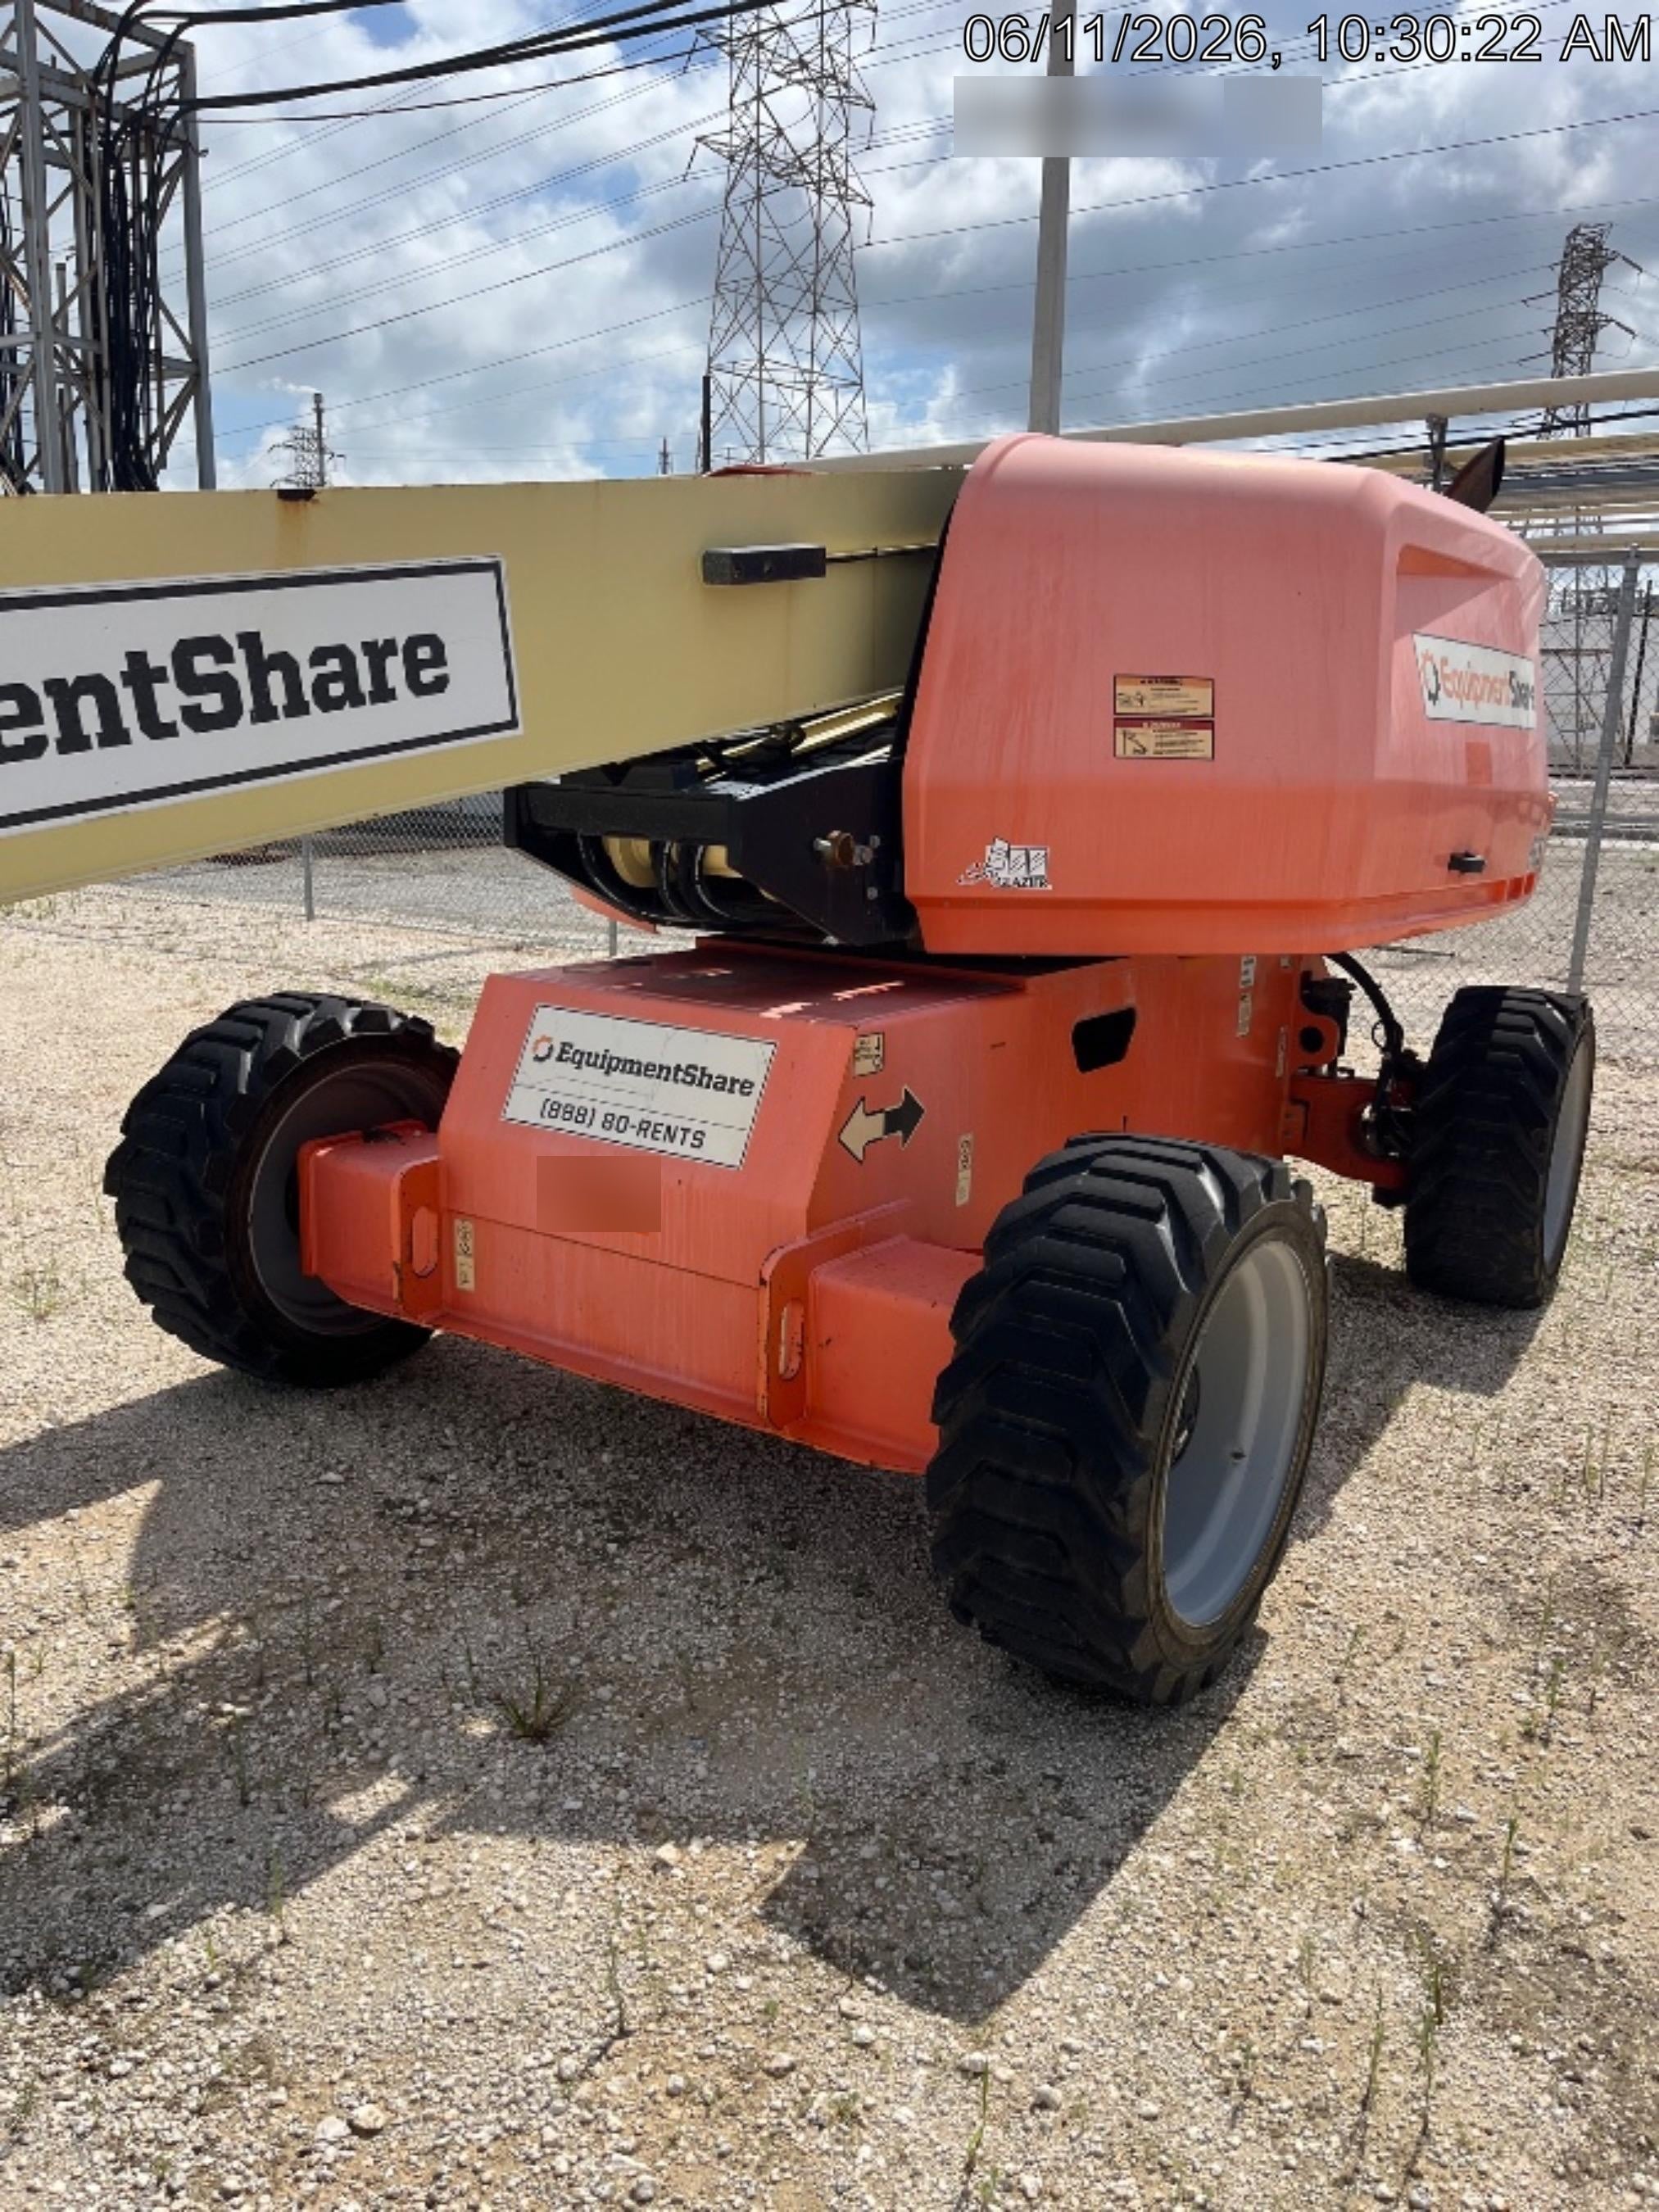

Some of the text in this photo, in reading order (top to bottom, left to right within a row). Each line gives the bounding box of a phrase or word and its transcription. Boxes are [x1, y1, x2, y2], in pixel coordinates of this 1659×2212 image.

[556, 1042, 755, 1096] EquipmentShare
[539, 1098, 706, 1149] (888) 80-RENTS
